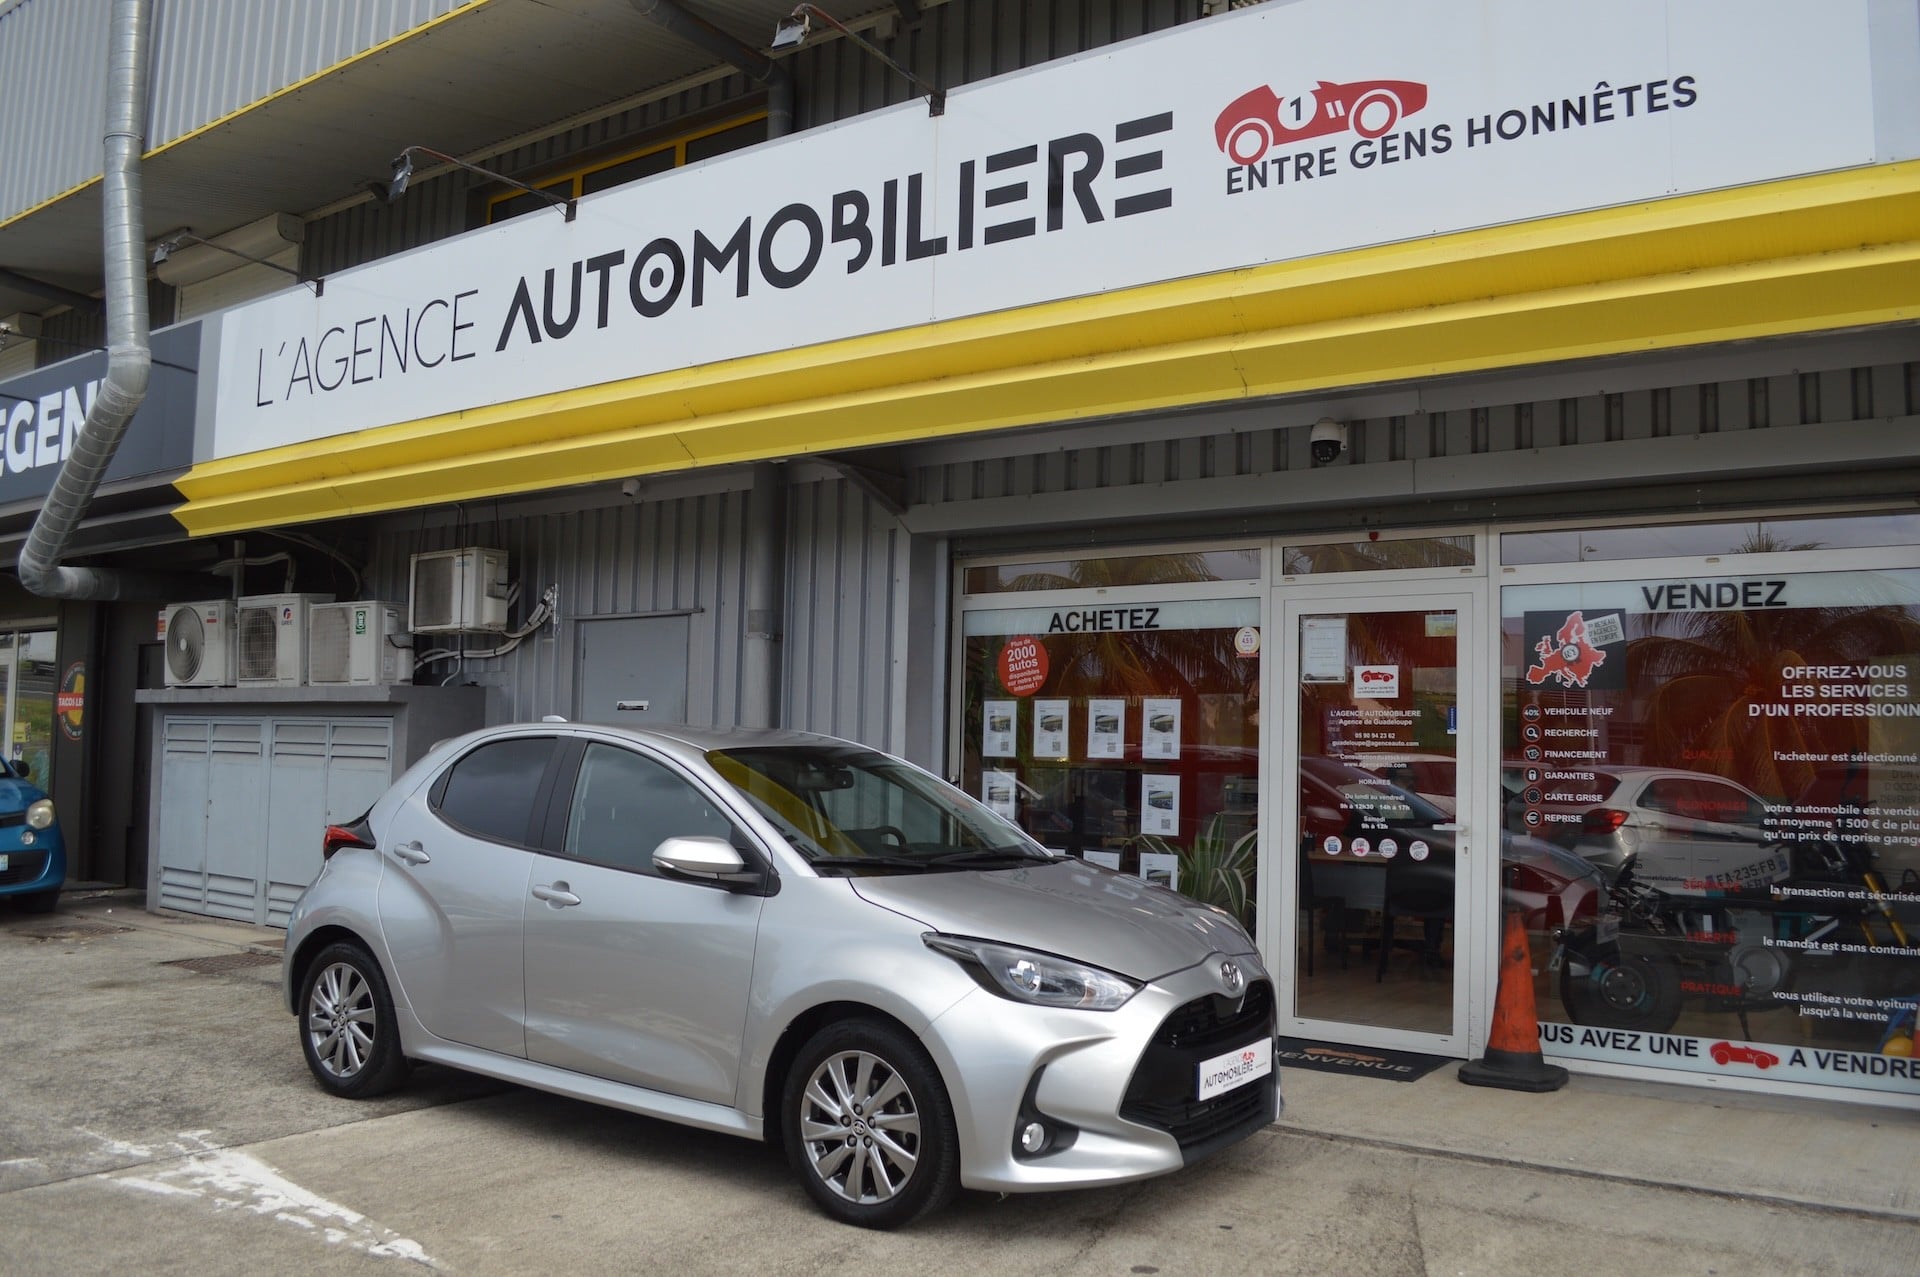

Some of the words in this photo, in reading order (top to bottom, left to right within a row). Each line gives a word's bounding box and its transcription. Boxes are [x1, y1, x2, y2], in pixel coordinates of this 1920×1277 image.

[1226, 145, 1337, 195] ENTRE
[1349, 124, 1451, 170] GENS
[1466, 75, 1698, 148] HONNÊTES
[255, 289, 478, 407] L'AGENCE
[495, 110, 1173, 352] AUTOMOBILIERE
[1641, 580, 1788, 610] VENDEZ
[1048, 607, 1160, 633] ACHETEZ
[1007, 644, 1036, 662] 2000
[1008, 658, 1039, 672] autos
[1008, 669, 1040, 680] disponibles
[1782, 665, 1907, 680] OFFREZ-VOUS
[1017, 677, 1032, 685] notre
[1032, 674, 1043, 682] site
[1782, 685, 1815, 698] LES
[1819, 684, 1908, 698] SERVICES
[1544, 708, 1588, 716] VEHICULE
[1589, 707, 1614, 715] NEUF
[1748, 704, 1790, 717] D'UN
[1373, 718, 1413, 726] Guadeloupe
[1544, 729, 1599, 737] RECHERCHE
[1544, 750, 1607, 759] FINANCEMENT
[1774, 750, 1829, 761] l'acheteur
[1831, 753, 1849, 762] est
[1850, 751, 1917, 763] sélectionné
[1544, 771, 1595, 780] GARANTIES
[1544, 793, 1574, 801] CARTE
[1575, 794, 1603, 802] GRISE
[1763, 804, 1792, 813] votre
[1794, 804, 1860, 815] automobile
[1862, 807, 1881, 816] est
[1544, 814, 1582, 823] REPRISE
[1763, 818, 1777, 826] en
[1780, 819, 1832, 828] moyenne
[1835, 818, 1842, 828] 1
[1846, 819, 1869, 829] 500
[1871, 819, 1880, 830] €
[1882, 819, 1898, 830] de
[1763, 831, 1796, 842] qu'un
[1798, 831, 1820, 843] prix
[1822, 832, 1838, 842] de
[1840, 833, 1881, 844] reprise
[1770, 884, 1780, 895] la
[1782, 886, 1845, 898] transaction
[1847, 890, 1866, 900] est
[1763, 936, 1774, 947] le
[1776, 937, 1819, 950] mandat
[1821, 942, 1840, 952] est
[1841, 945, 1867, 954] sans
[1772, 991, 1799, 1001] vous
[1801, 992, 1841, 1005] utilisez
[1843, 996, 1875, 1007] votre
[1876, 998, 1918, 1011] voiture
[1798, 1005, 1840, 1019] jusqu'à
[1842, 1008, 1854, 1019] la
[1855, 1011, 1889, 1022] vente
[1580, 1029, 1642, 1052] AVEZ
[1648, 1036, 1699, 1058] UNE
[1788, 1048, 1807, 1068] A
